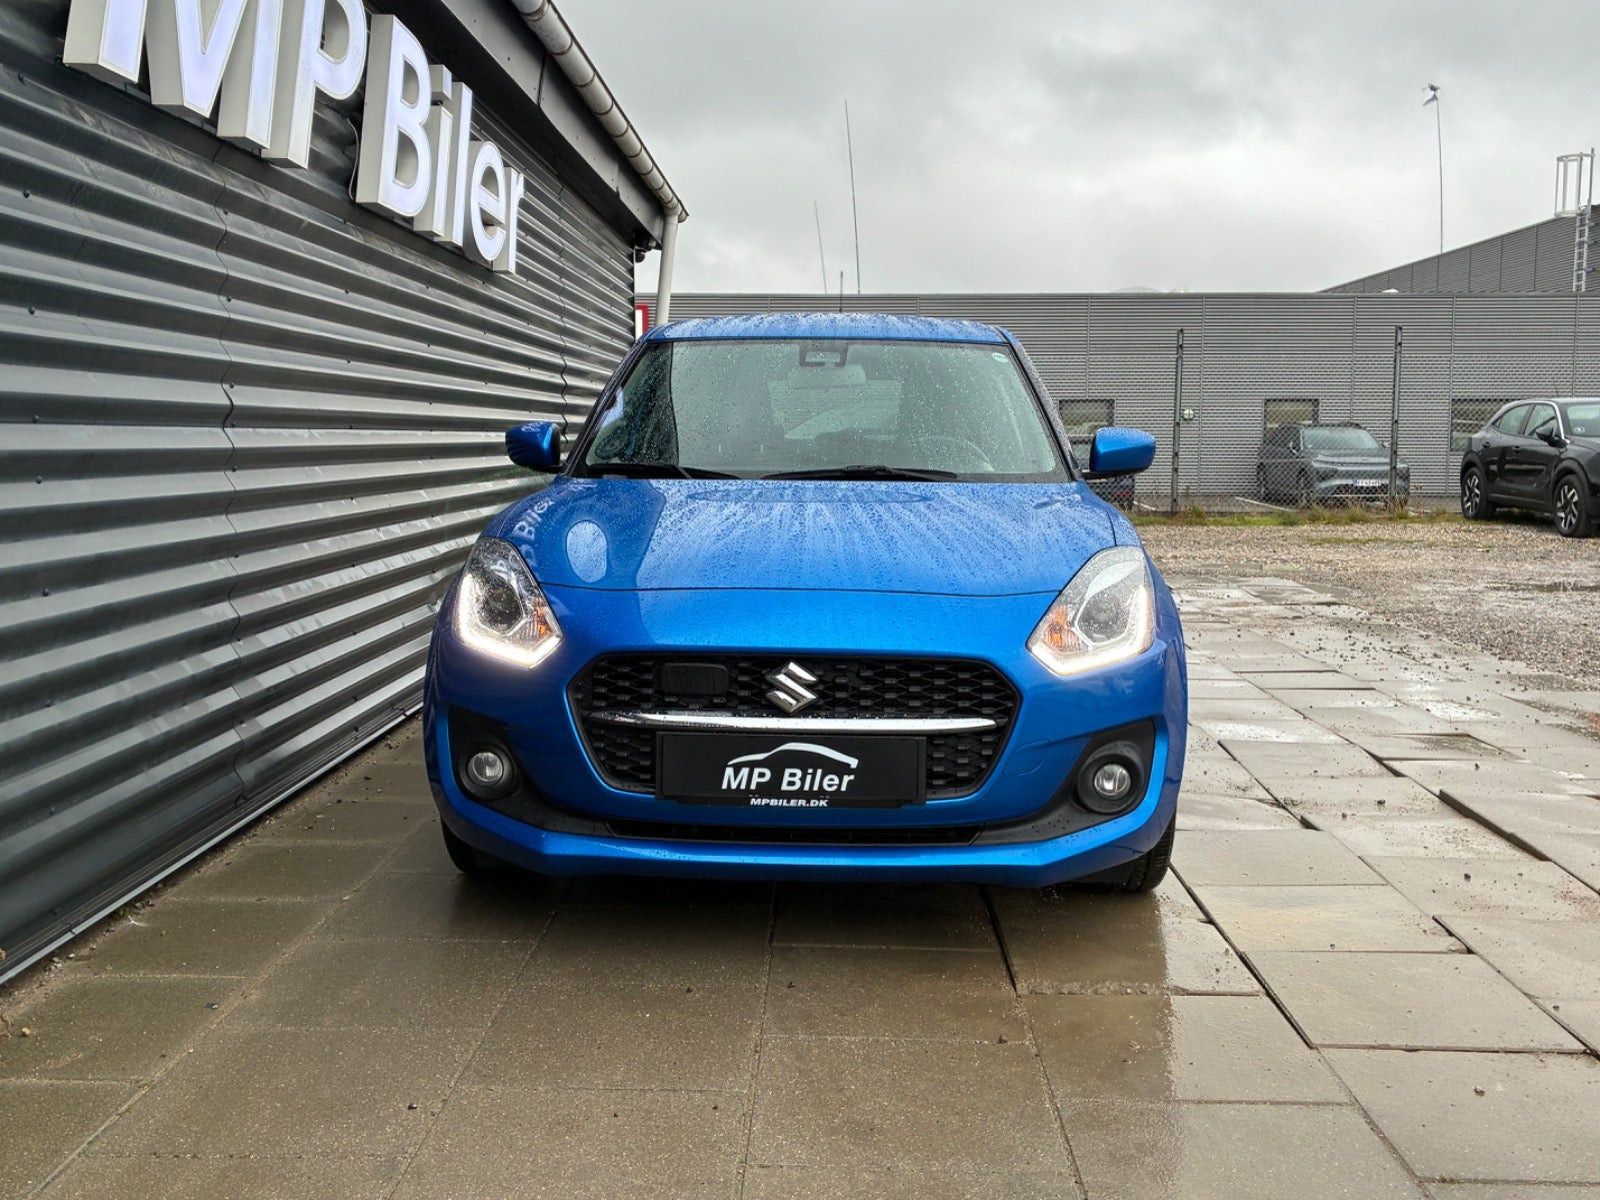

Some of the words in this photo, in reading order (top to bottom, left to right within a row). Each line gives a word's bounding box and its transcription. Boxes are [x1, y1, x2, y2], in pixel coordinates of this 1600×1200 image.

[356, 14, 526, 275] Biler
[721, 767, 772, 790] MP
[780, 768, 855, 792] Biler
[750, 797, 829, 808] MPBILER.DK
